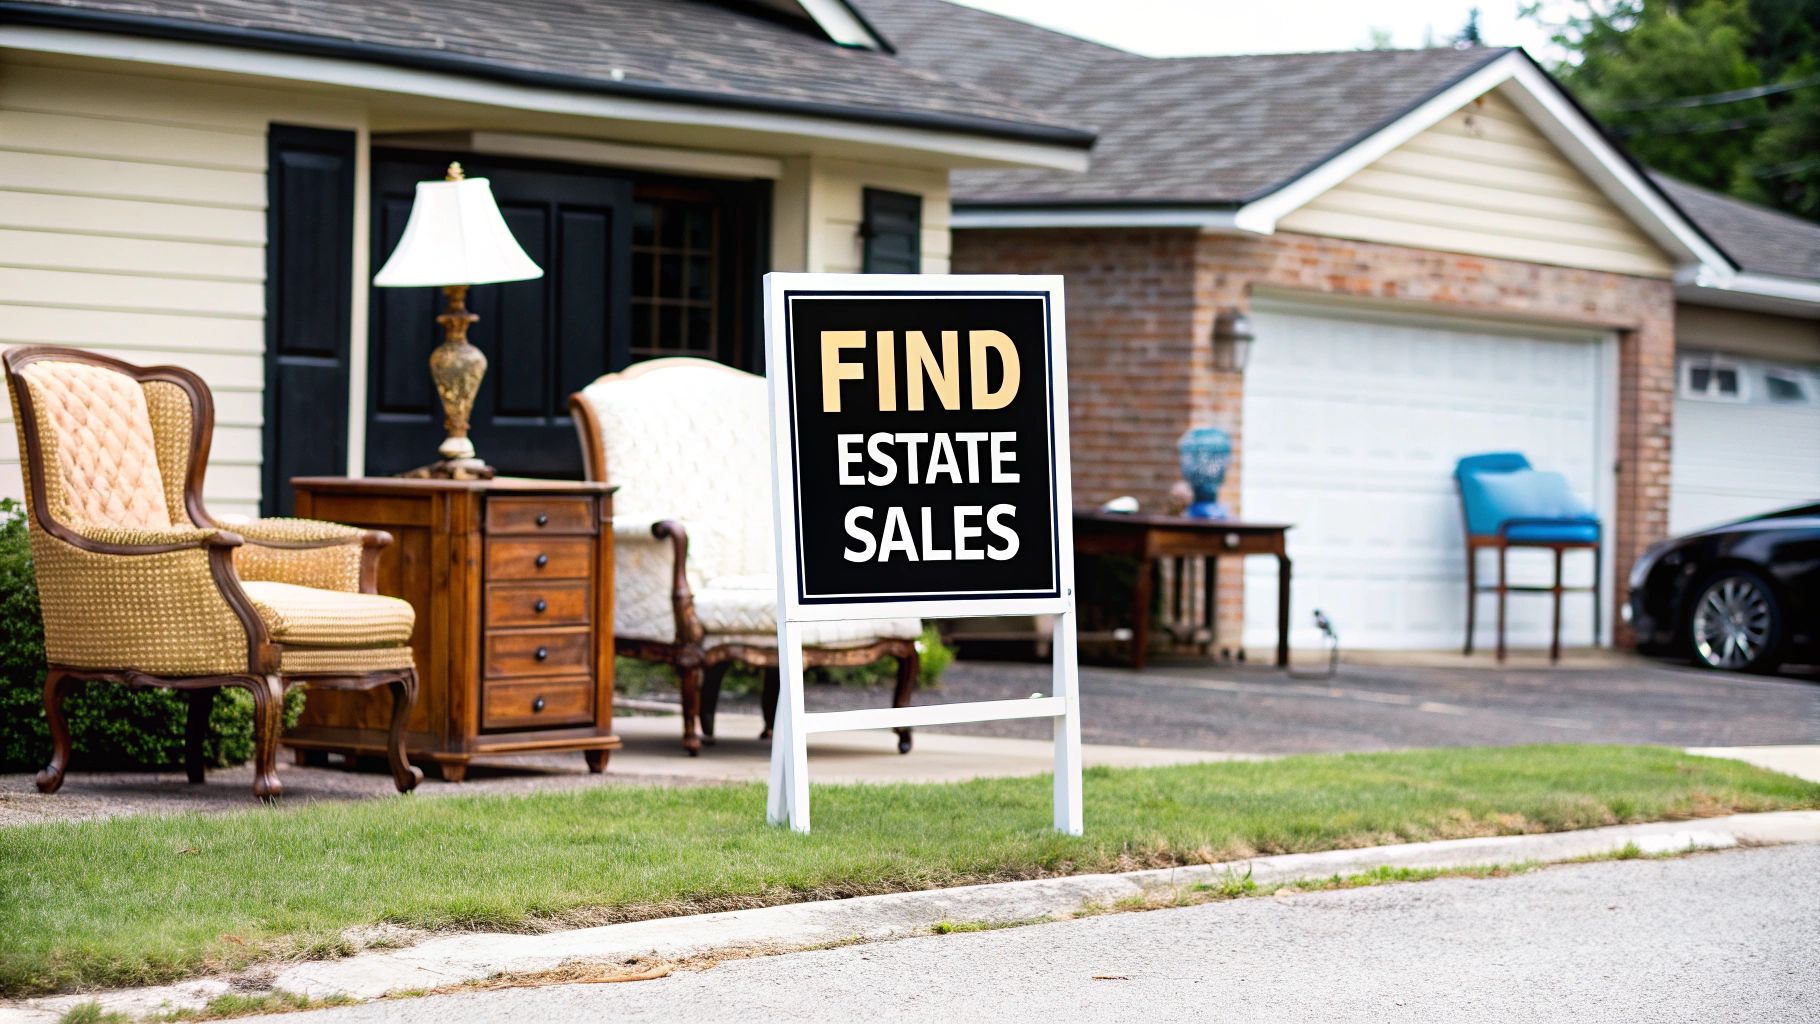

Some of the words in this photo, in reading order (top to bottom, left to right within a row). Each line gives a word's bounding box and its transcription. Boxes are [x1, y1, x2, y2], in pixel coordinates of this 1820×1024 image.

[820, 330, 1021, 412] FIND
[838, 432, 1020, 486] ESTATE
[843, 504, 1020, 563] SALES
